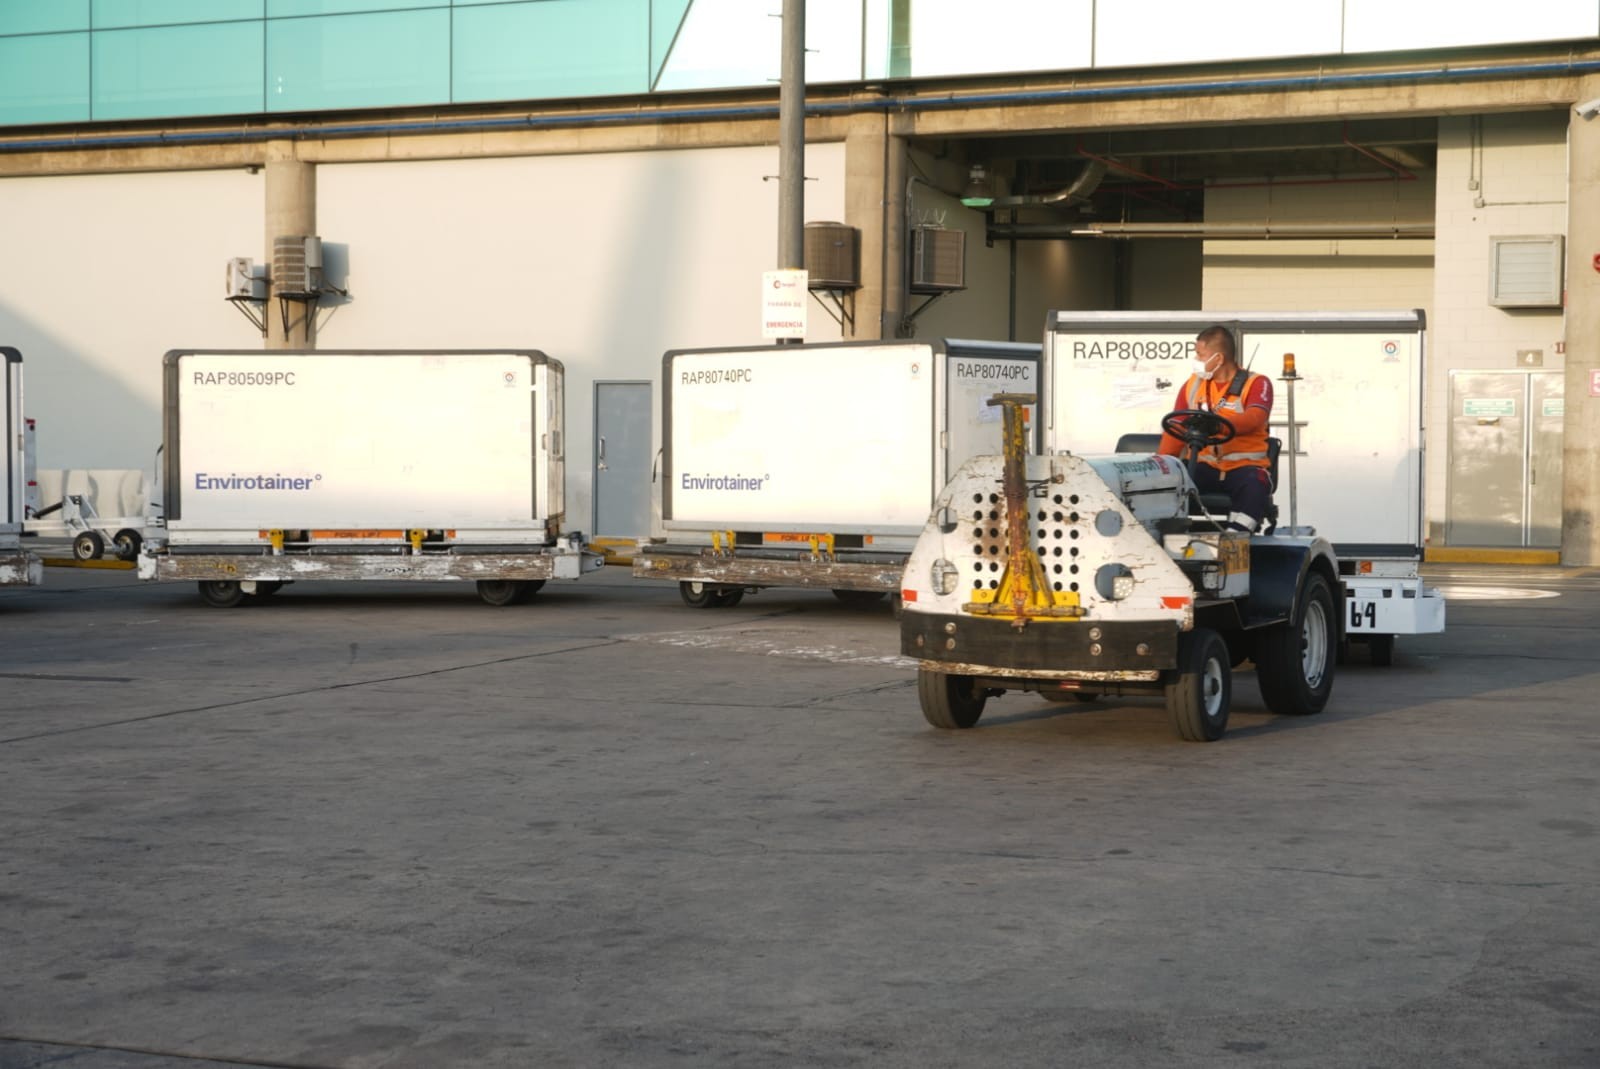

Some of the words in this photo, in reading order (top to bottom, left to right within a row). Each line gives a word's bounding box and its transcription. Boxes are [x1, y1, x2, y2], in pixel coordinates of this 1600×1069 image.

[1073, 341, 1197, 360] RAP80892P
[193, 371, 296, 386] RAP80509PC
[681, 368, 752, 385] RAP80740PC
[957, 362, 1030, 380] RAP80740PC
[194, 473, 313, 490] Envirotainer
[681, 472, 764, 491] Envirotainer
